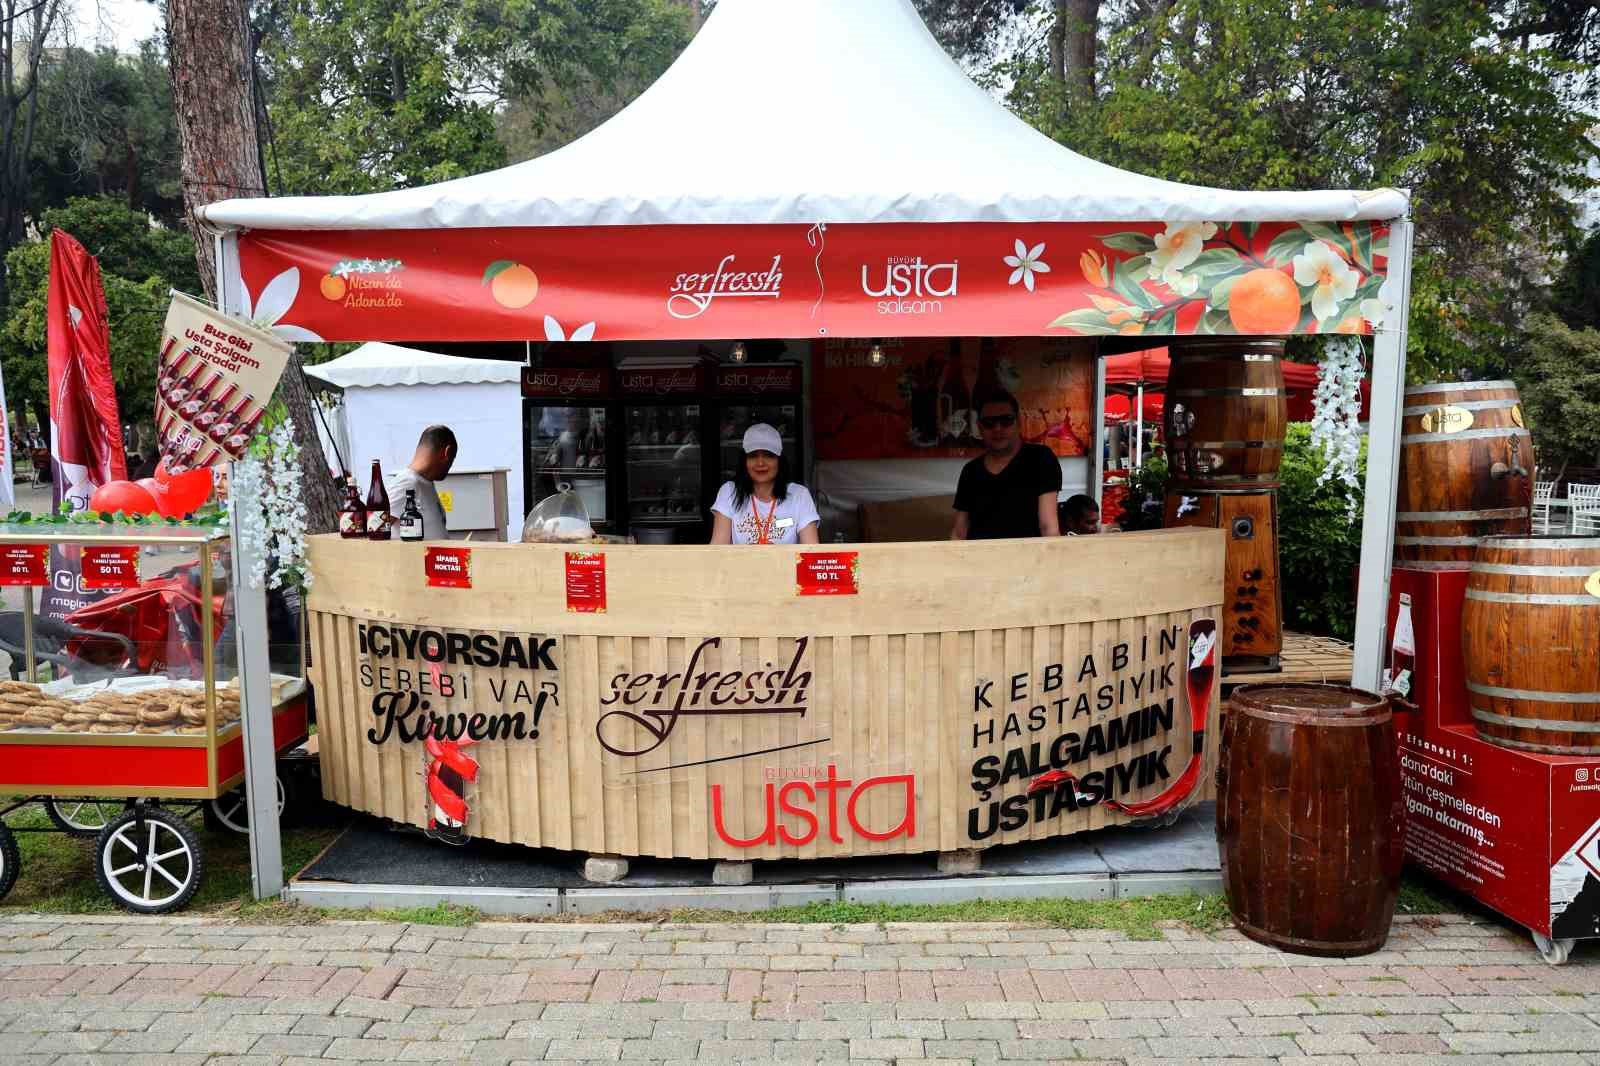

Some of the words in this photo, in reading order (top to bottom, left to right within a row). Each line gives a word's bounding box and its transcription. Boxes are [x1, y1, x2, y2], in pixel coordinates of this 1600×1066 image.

[862, 256, 957, 297] usta
[184, 328, 213, 348] Usta
[213, 342, 260, 369] Şalgam
[192, 345, 241, 374] Burada!
[203, 323, 227, 341] Buz
[227, 335, 254, 351] Gibi
[526, 371, 558, 386] usta
[100, 566, 111, 574] 50
[112, 566, 123, 574] TL
[829, 572, 841, 580] TL
[358, 624, 559, 671] İÇİYORSAK
[974, 624, 1177, 712] KEBABIN
[360, 664, 468, 699] SEBEBİ
[489, 677, 560, 707] VAR
[596, 636, 812, 756] serfressh
[973, 661, 1176, 749] HASTASIYIK
[367, 690, 548, 745] Kirvem!
[971, 698, 1174, 802] ŞALGAMIN
[1401, 754, 1454, 786] dana'daki
[1407, 734, 1456, 761] Efsanesi
[1462, 754, 1473, 767] 1:
[711, 764, 916, 848] usta
[968, 744, 1172, 841] USTASIYIK
[1404, 775, 1425, 793] tün
[1425, 785, 1502, 829] çeşmelerden
[1406, 794, 1434, 818] lgam
[1435, 810, 1495, 847] akarmış...
